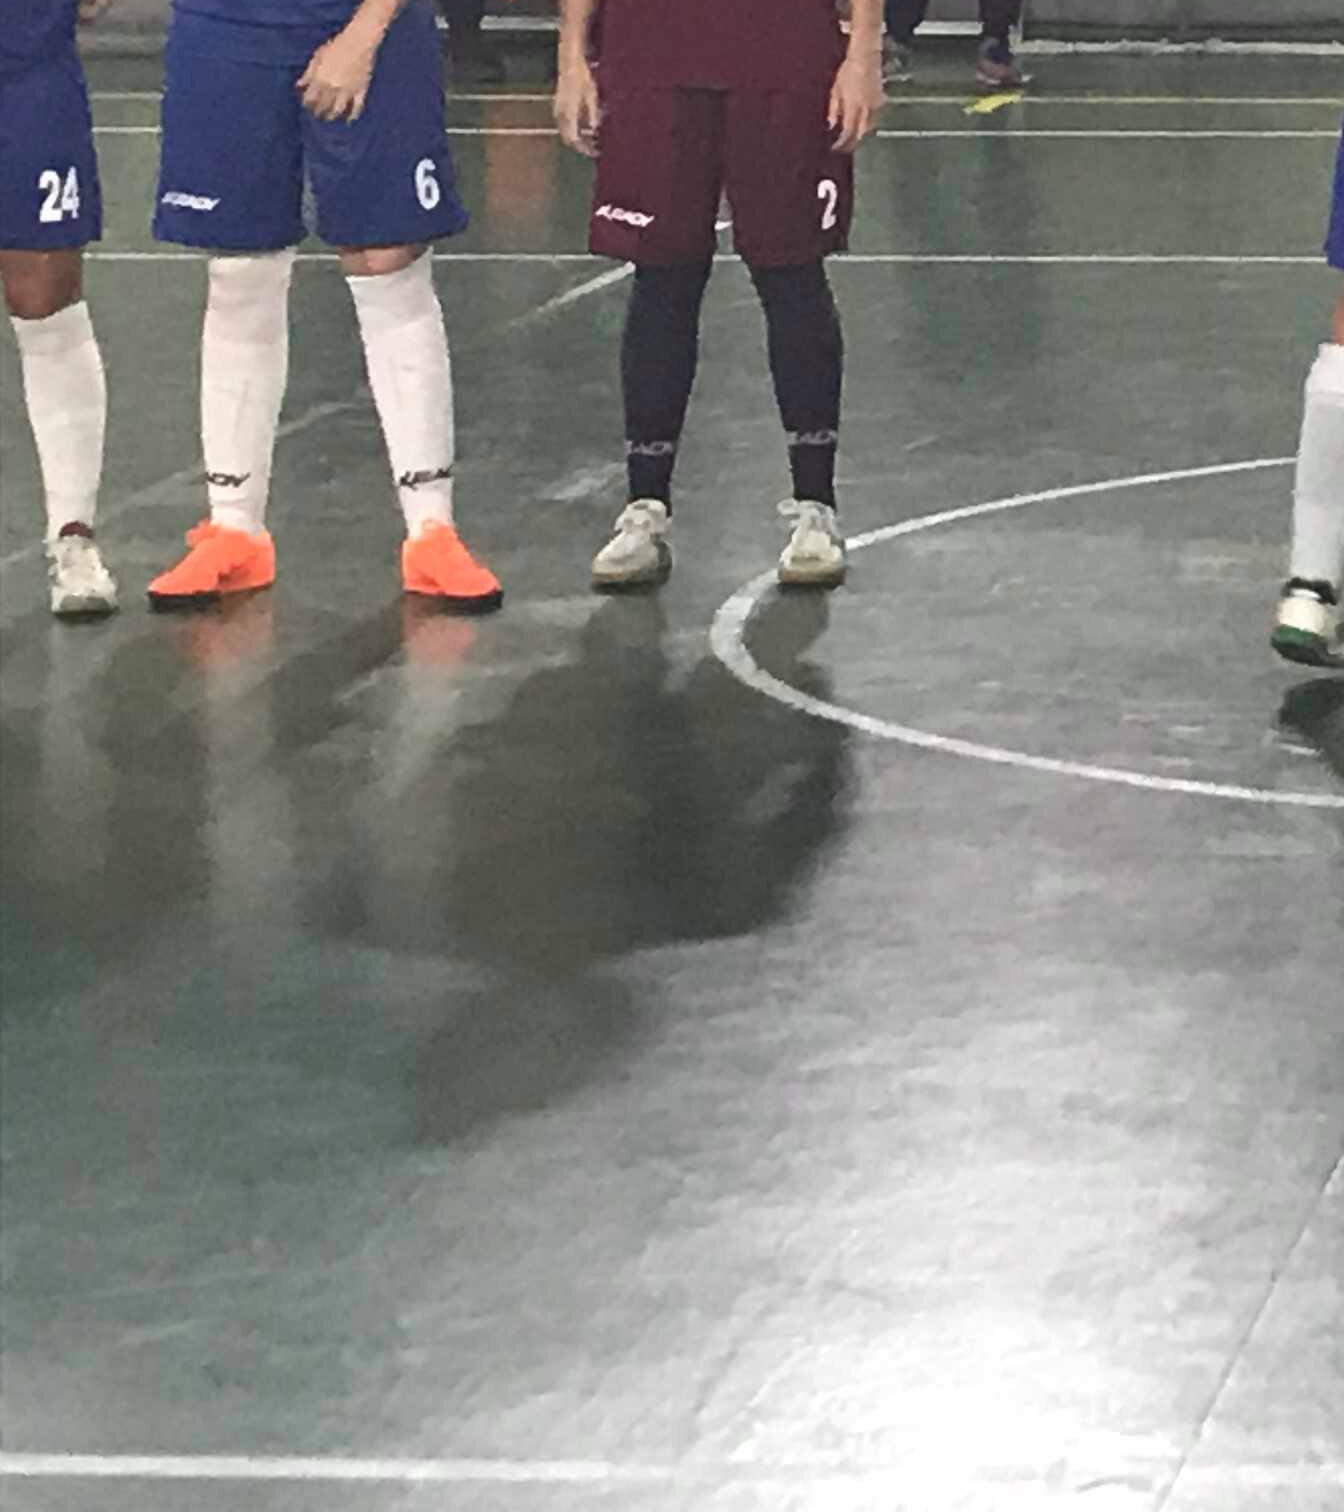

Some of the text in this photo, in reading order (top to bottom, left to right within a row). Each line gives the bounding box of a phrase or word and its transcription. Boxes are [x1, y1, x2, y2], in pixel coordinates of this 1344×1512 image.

[39, 166, 80, 224] 24
[414, 157, 440, 211] 6
[816, 178, 839, 231] 2
